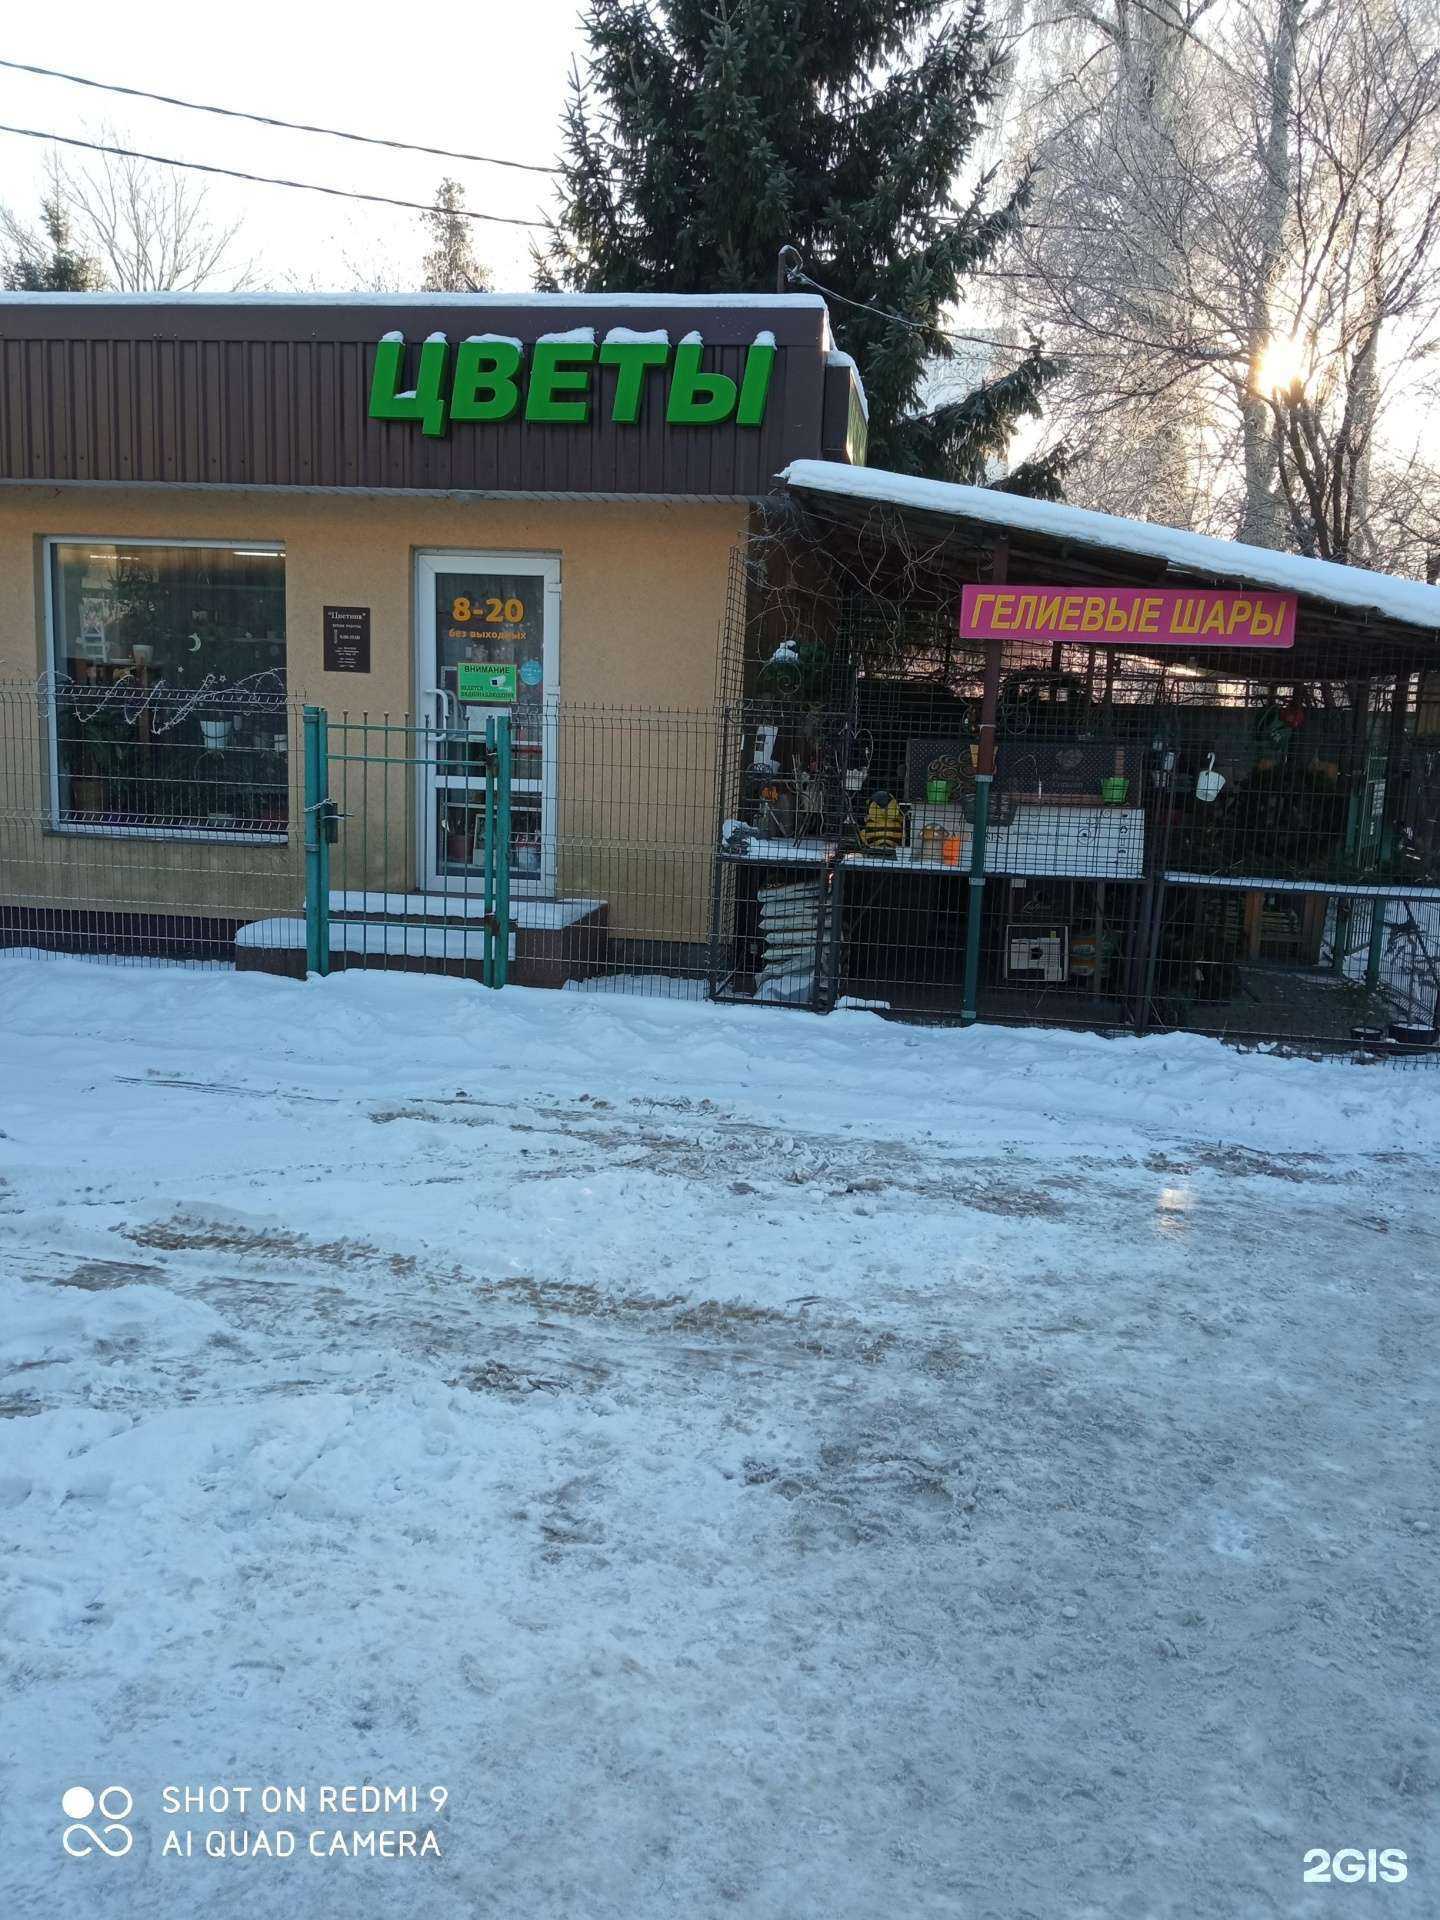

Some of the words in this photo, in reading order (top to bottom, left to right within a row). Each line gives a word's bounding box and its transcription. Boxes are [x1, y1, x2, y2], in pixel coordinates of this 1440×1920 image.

[368, 340, 776, 437] ЦВЕТЫ
[452, 597, 524, 623] 8-20
[971, 593, 1163, 633] ГЕЛИЕВЫЕ
[1169, 598, 1286, 636] ШАРЫ
[448, 628, 466, 638] без
[470, 631, 526, 640] выходных
[464, 666, 510, 674] ВНИМАНИЕ
